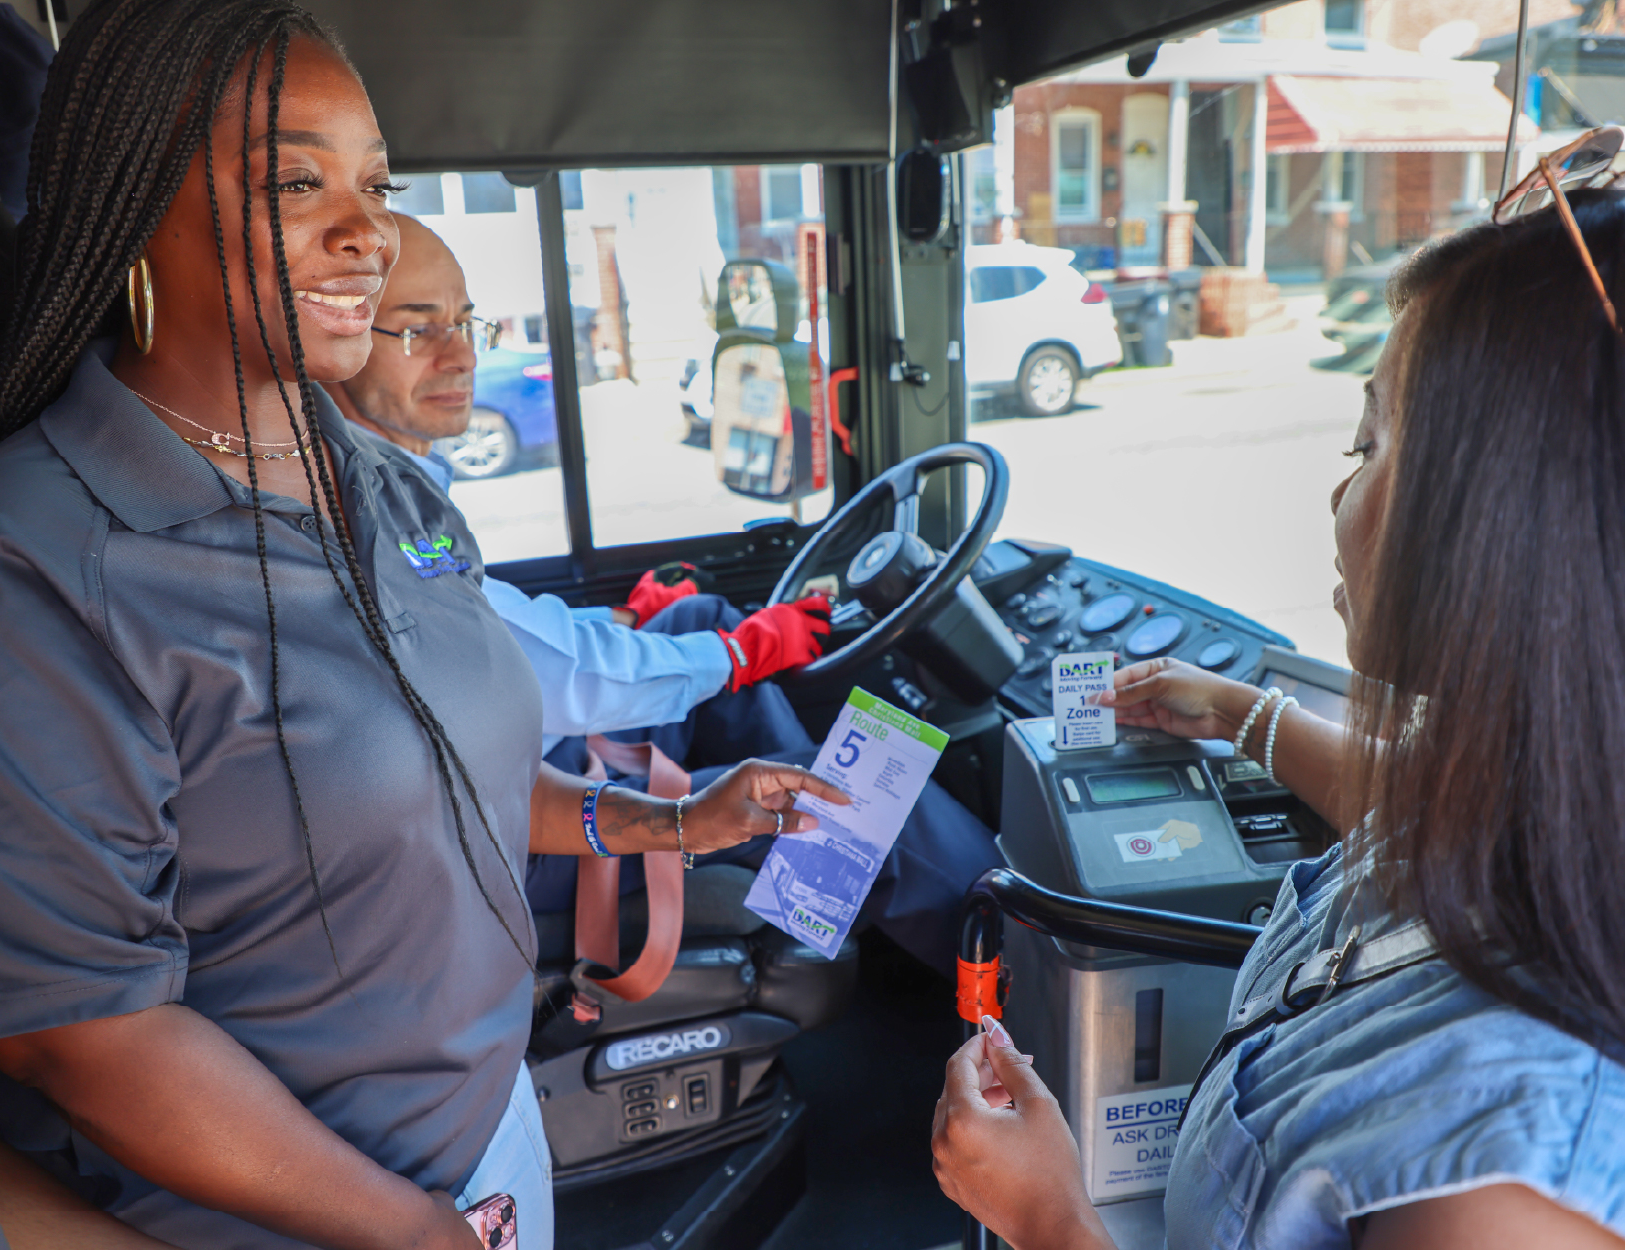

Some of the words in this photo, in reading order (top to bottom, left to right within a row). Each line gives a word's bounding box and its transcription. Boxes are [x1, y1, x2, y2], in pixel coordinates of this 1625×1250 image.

[1059, 660, 1109, 677] DART
[1059, 685, 1083, 693] DAILY
[1080, 695, 1085, 706] 1
[873, 701, 907, 723] Maryland
[1067, 708, 1101, 719] Zone
[848, 709, 889, 742] Route
[903, 724, 921, 738] Mall
[835, 729, 867, 768] 5
[792, 908, 835, 937] DART
[618, 1026, 722, 1066] RECARO
[1106, 1098, 1188, 1122] BEFORE
[1113, 1129, 1149, 1146] ASK
[1137, 1146, 1175, 1162] DAIL
